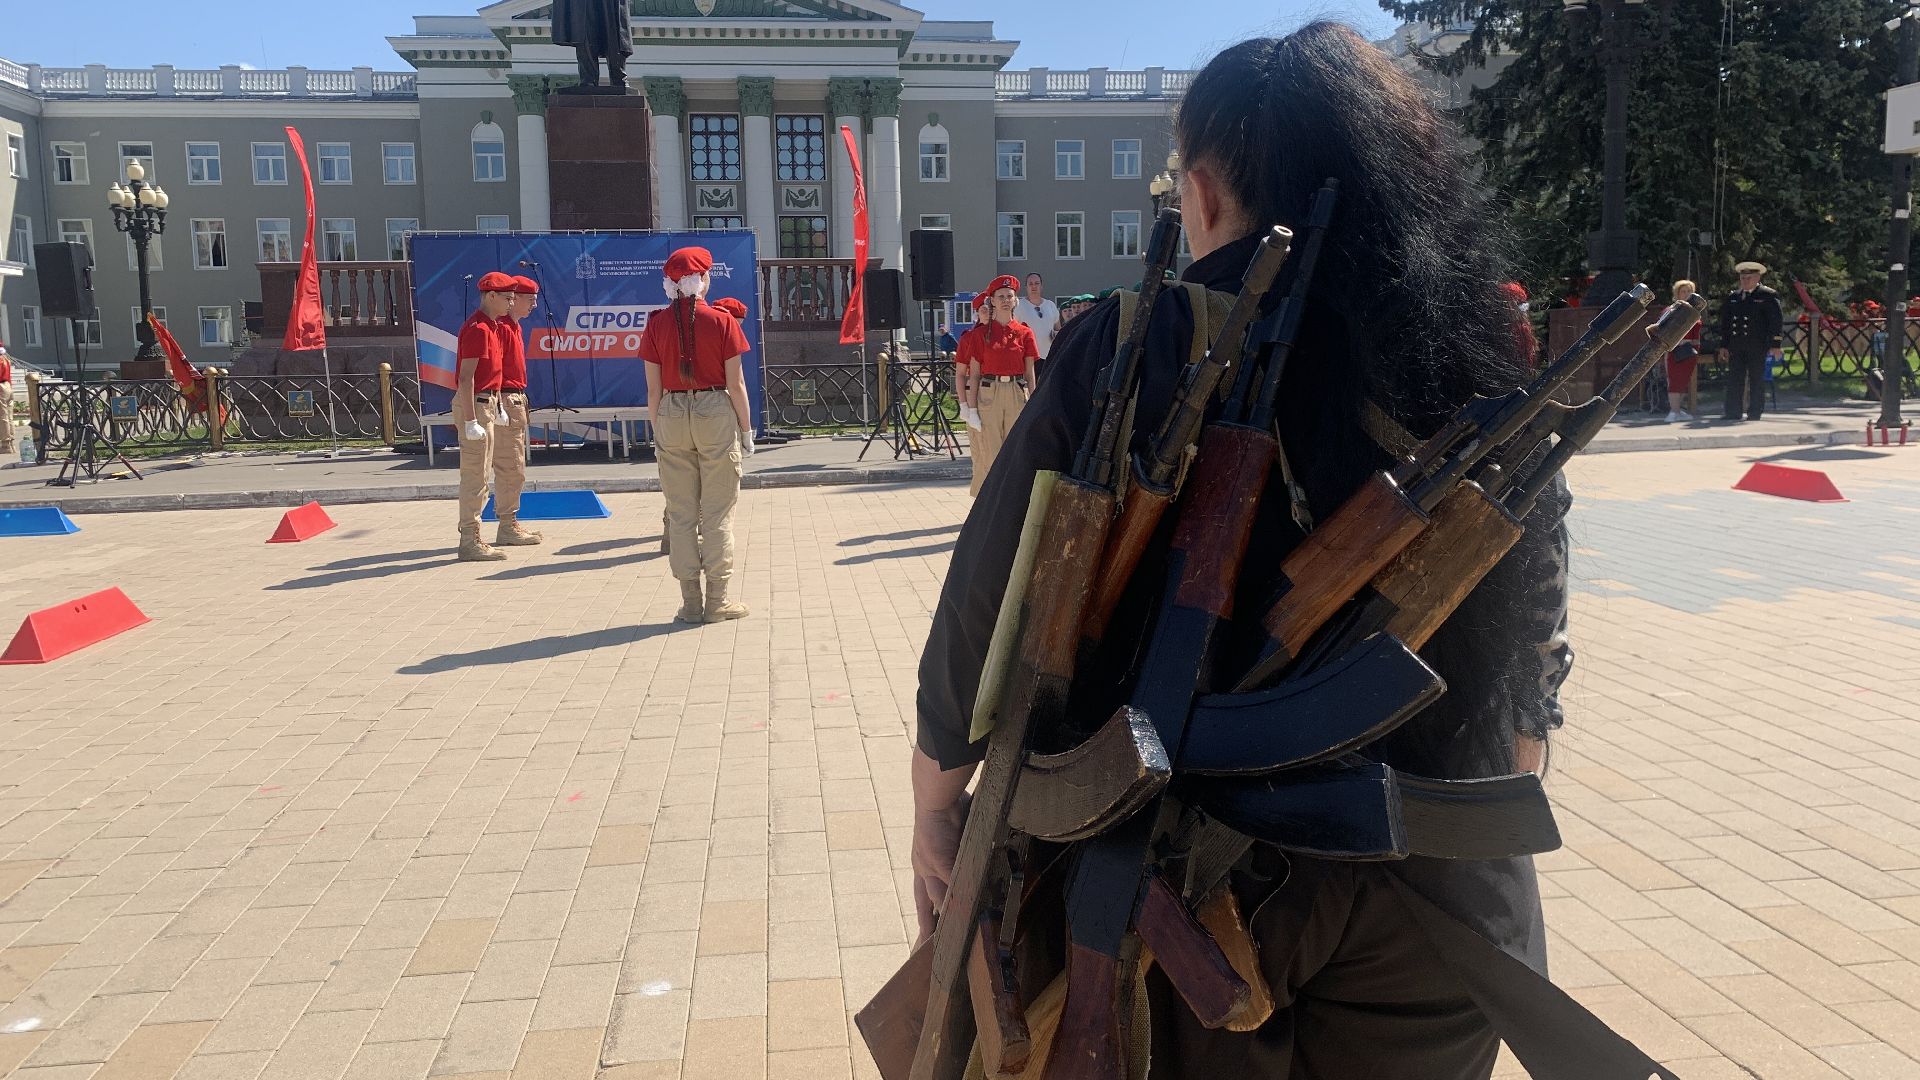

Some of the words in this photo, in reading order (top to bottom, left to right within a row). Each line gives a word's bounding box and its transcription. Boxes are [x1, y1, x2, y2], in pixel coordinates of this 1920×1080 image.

[575, 311, 648, 329] СТРОЕ
[539, 334, 618, 352] СМОТР
[623, 334, 643, 351] О
